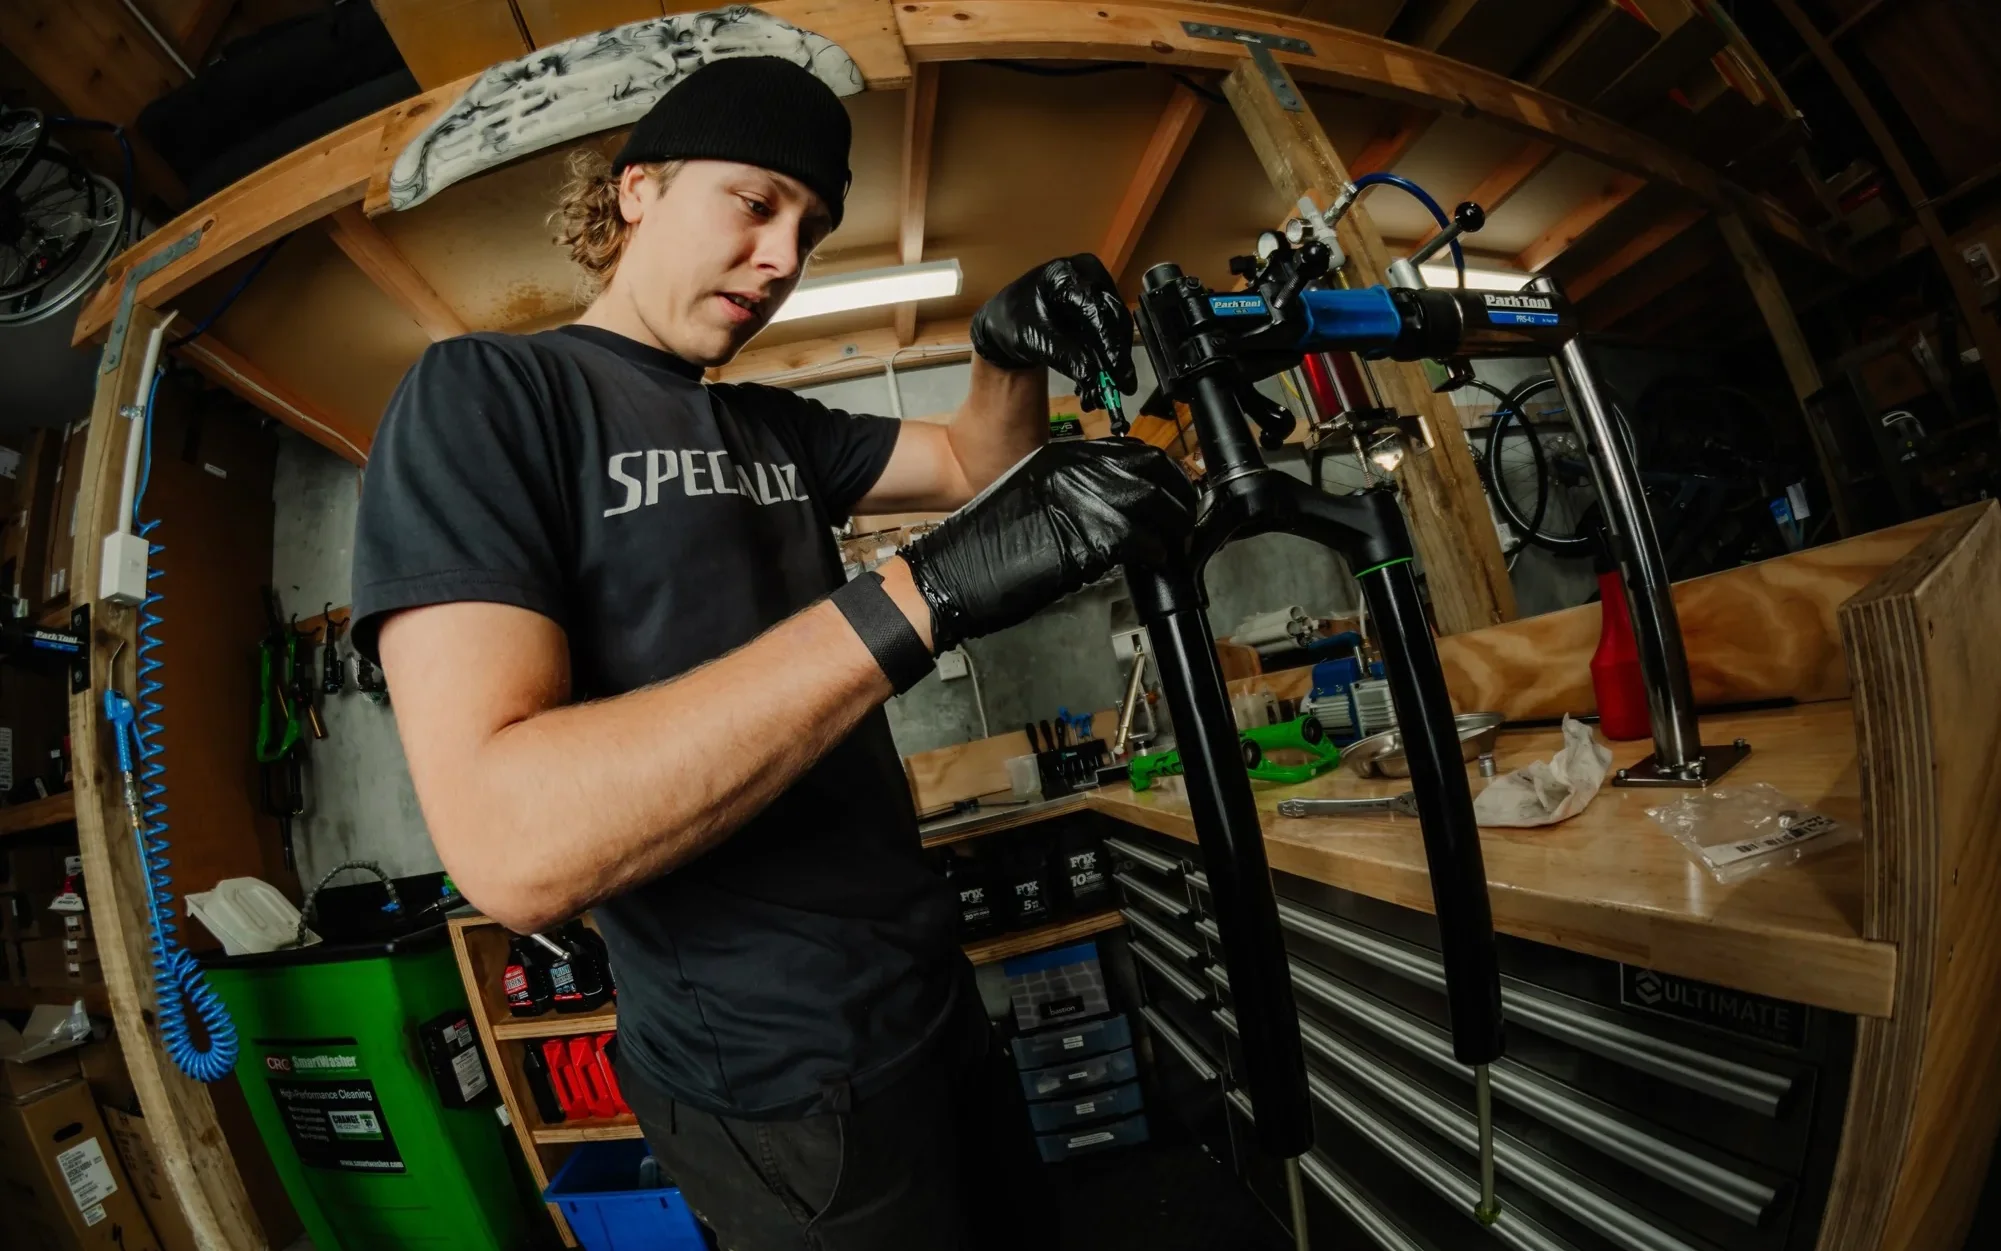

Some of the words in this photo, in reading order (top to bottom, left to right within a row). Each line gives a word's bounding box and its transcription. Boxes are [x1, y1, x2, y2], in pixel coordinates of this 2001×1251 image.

[1070, 852, 1096, 870] FOX
[1070, 874, 1087, 887] 10
[960, 888, 984, 903] FOX
[1016, 881, 1039, 896] FOX
[1024, 900, 1032, 910] 5
[1049, 1004, 1075, 1016] bastion
[1664, 980, 1790, 1031] ULTIMATE
[267, 1057, 291, 1071] CRC
[292, 1055, 357, 1068] SmartWasher
[338, 1089, 372, 1102] Cleaning
[332, 1115, 360, 1124] CHANGE
